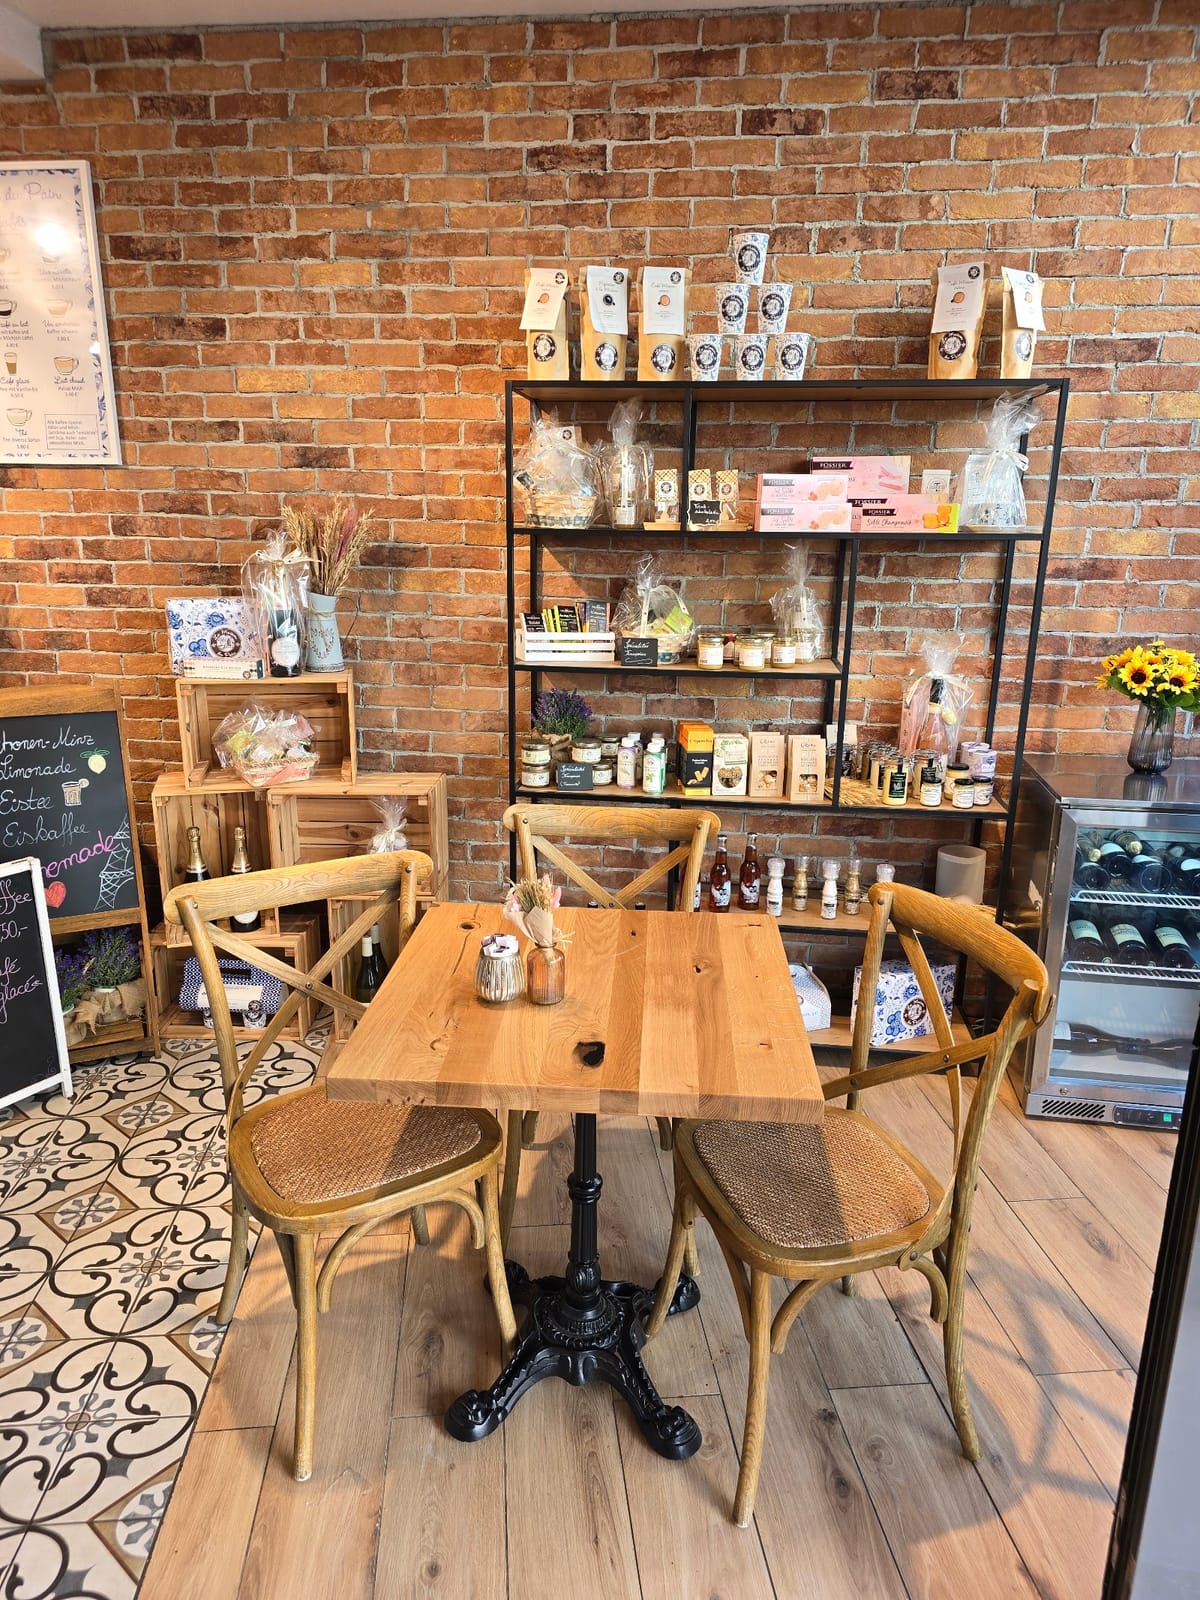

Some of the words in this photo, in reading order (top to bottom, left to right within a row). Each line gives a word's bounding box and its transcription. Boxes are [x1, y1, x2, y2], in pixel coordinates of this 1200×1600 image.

[24, 181, 62, 201] Pain
[819, 462, 848, 470] FOSSIER
[0, 754, 76, 780] Limonade
[0, 786, 54, 815] Eistee
[3, 811, 90, 849] Eiskaffee
[0, 975, 36, 1024] glacé
